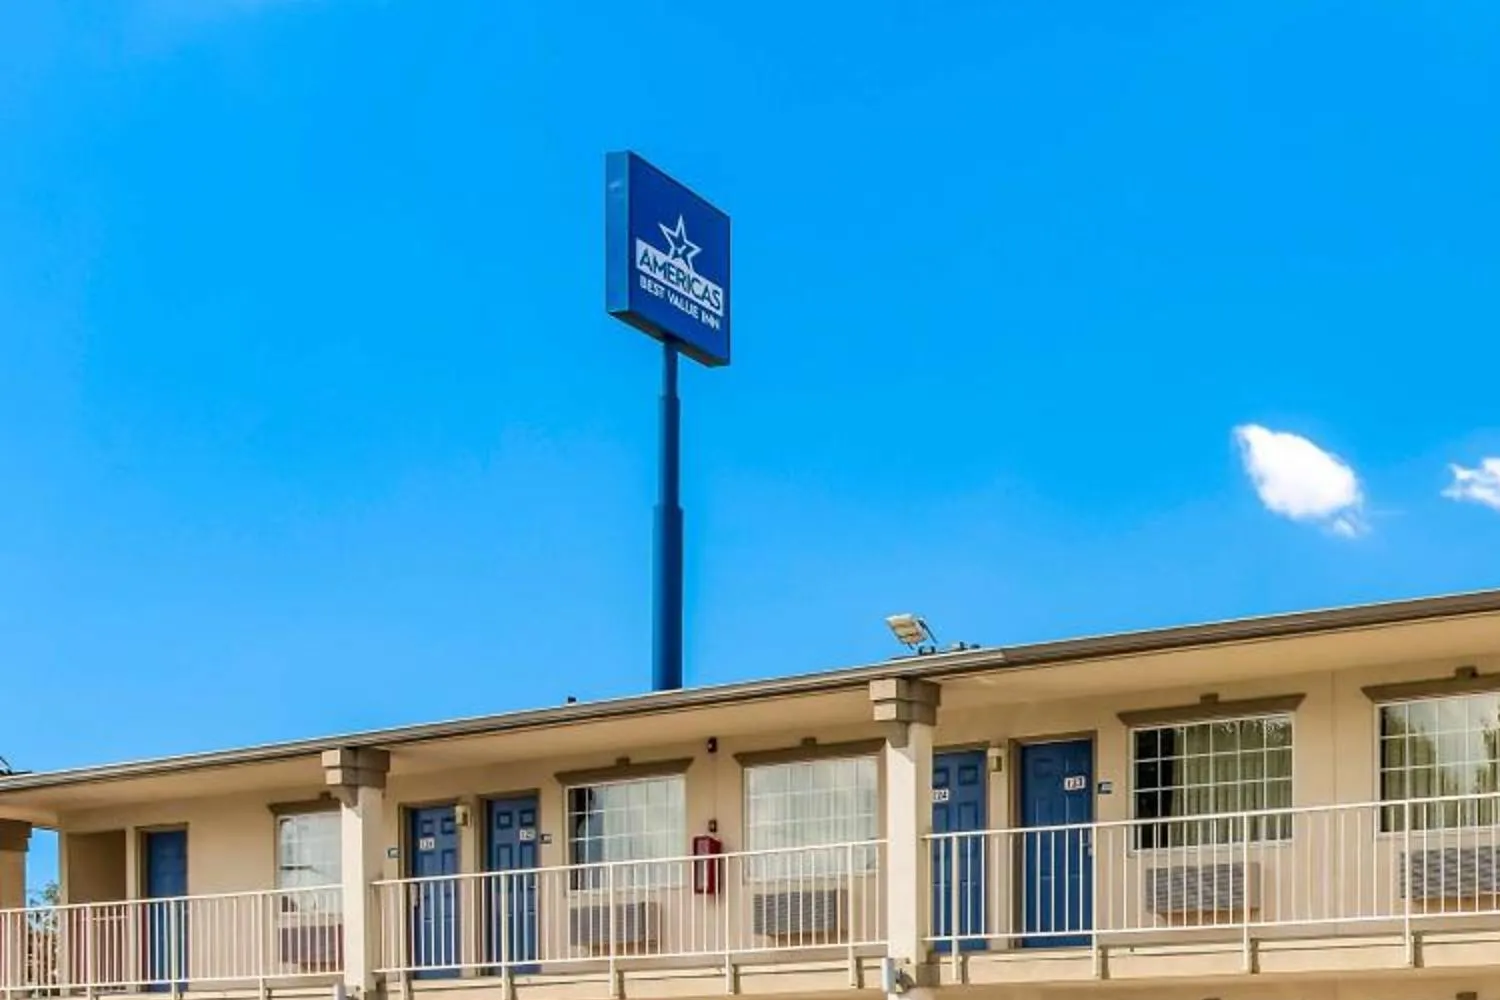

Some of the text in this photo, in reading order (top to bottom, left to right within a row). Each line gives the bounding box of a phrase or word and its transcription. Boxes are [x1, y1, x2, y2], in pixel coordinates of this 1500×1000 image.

[640, 249, 721, 311] AMERICAS
[640, 275, 720, 330] BEST VALUE INN
